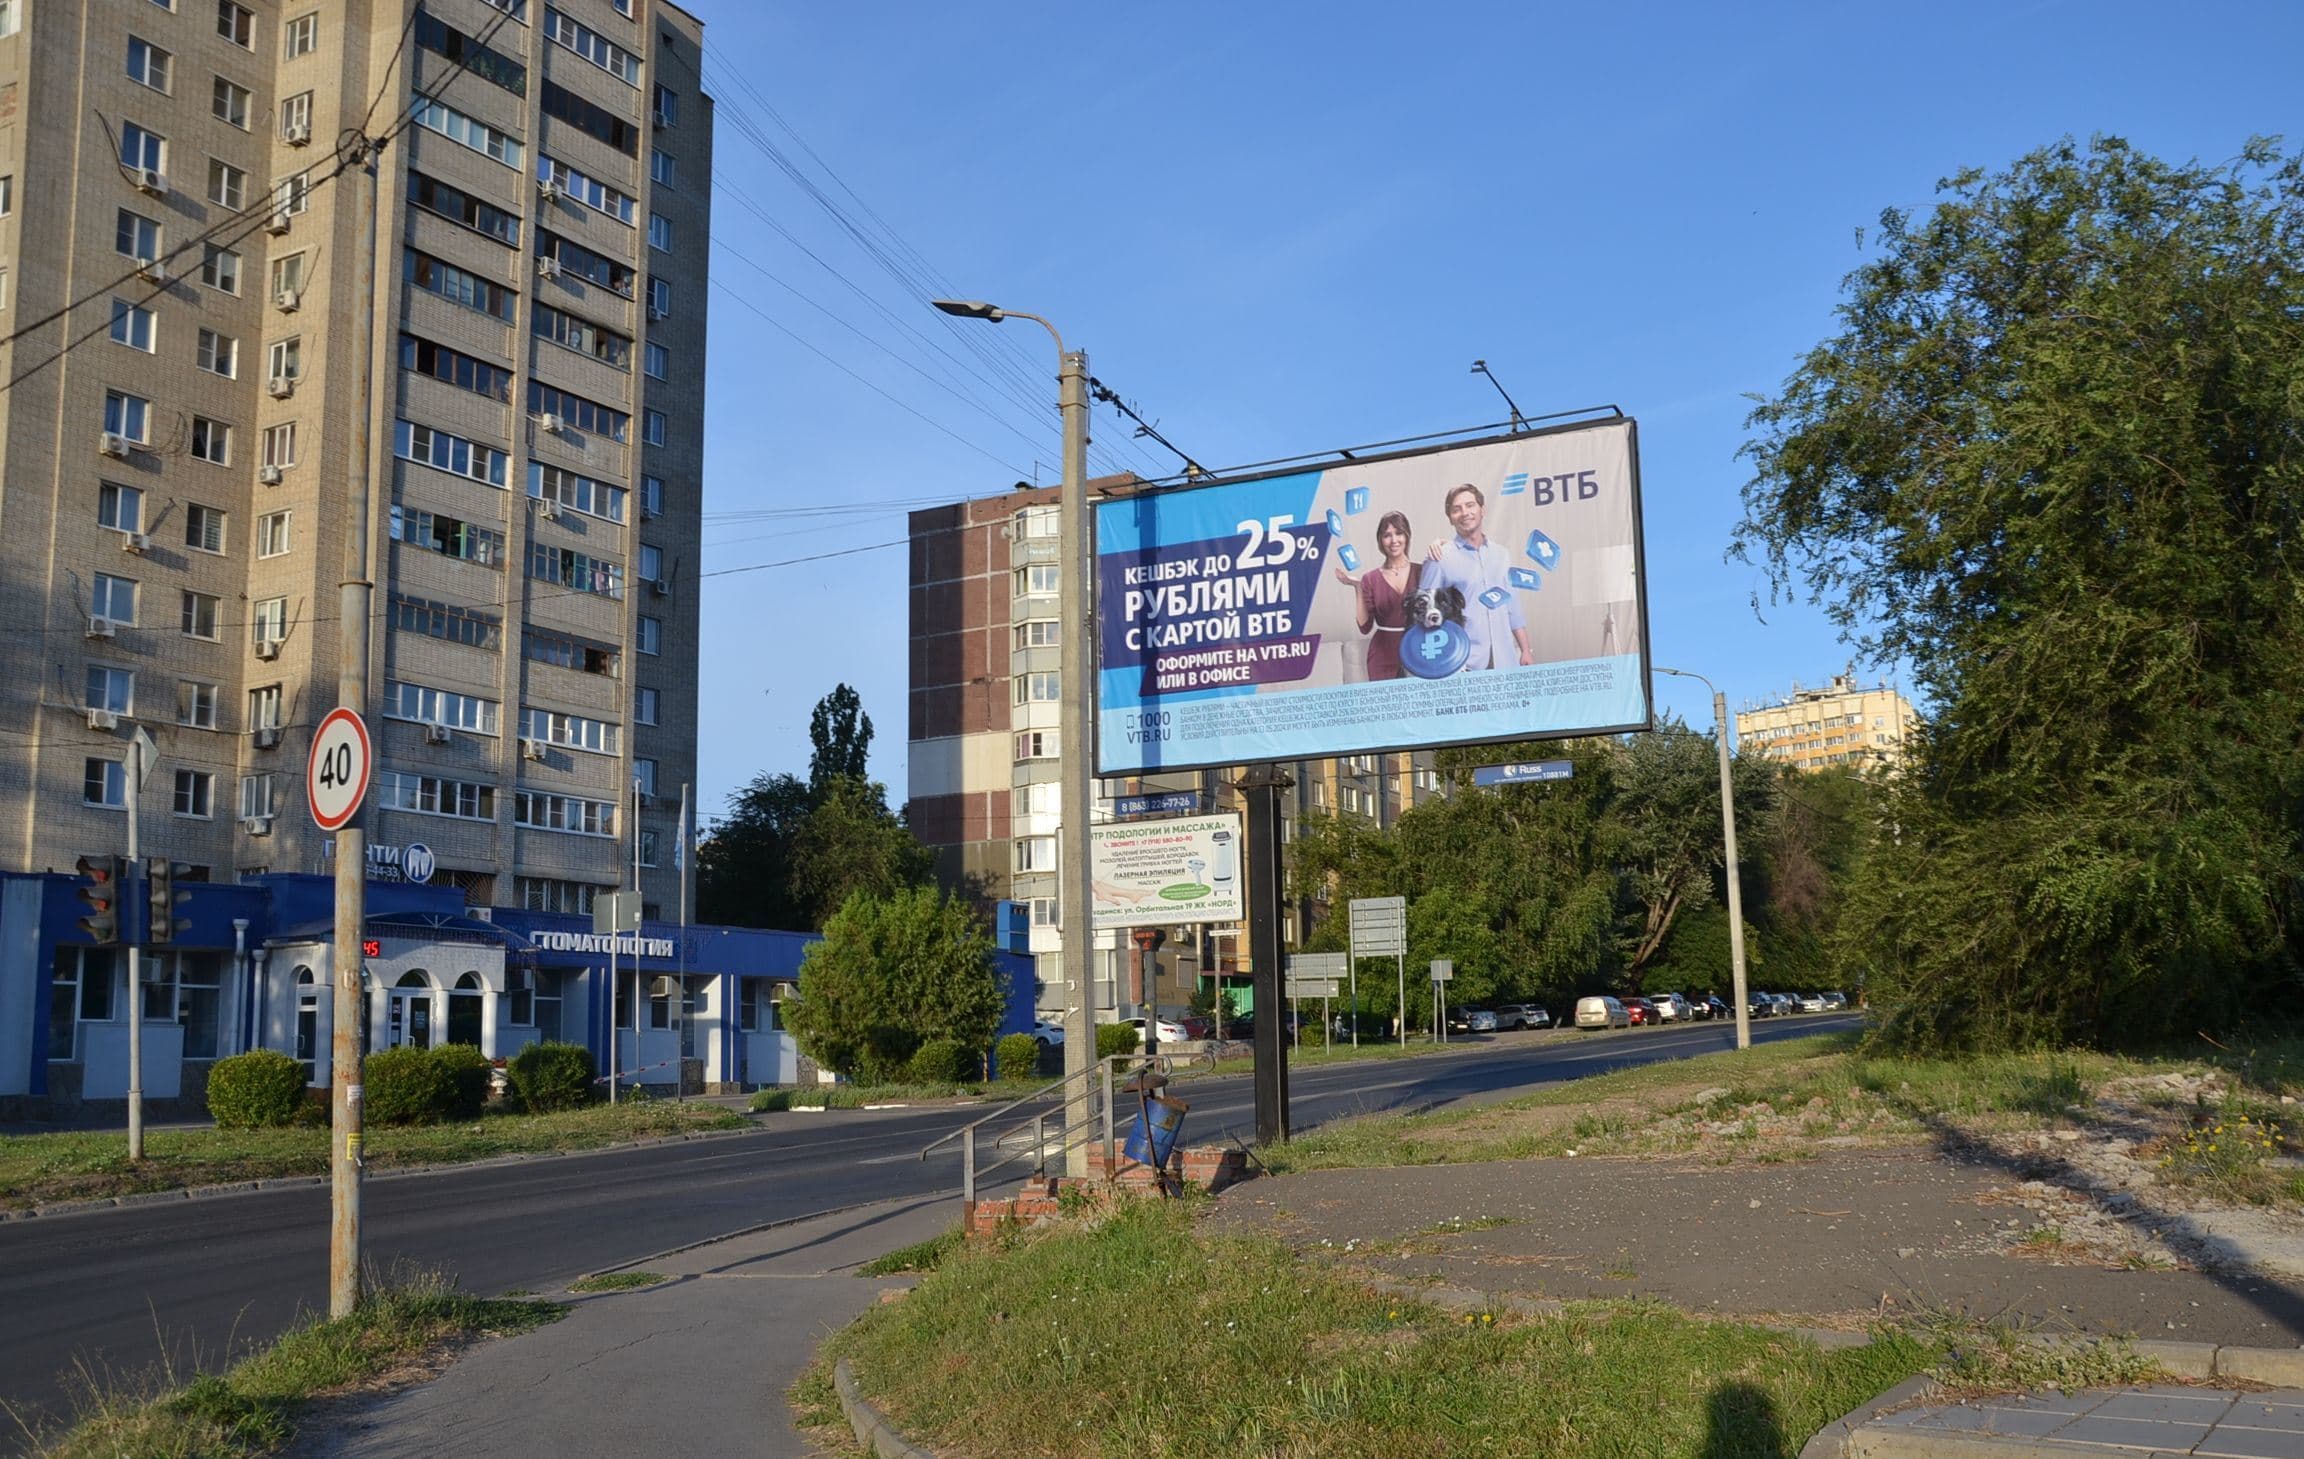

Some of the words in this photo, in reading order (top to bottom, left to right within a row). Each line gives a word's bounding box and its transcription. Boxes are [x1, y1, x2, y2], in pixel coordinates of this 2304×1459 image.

[1534, 470, 1598, 506] ВТБ
[1125, 558, 1198, 585] КЕШБЭК
[1203, 554, 1231, 577] ДО
[1235, 514, 1319, 570] 25%
[1125, 570, 1290, 622] РУБЛЯМИ
[1126, 628, 1141, 650] С
[1146, 611, 1240, 648] КАРТОЙ
[1248, 610, 1292, 637] ВТБ
[1156, 650, 1233, 672] ОФОРМИТЕ
[1236, 648, 1258, 663] НА
[1260, 641, 1311, 660] VTB.RU
[1156, 673, 1186, 689] ИЛИ
[1188, 671, 1198, 685] В
[1200, 665, 1250, 684] ОФИСЕ
[1137, 711, 1171, 728] 1000
[1127, 728, 1171, 744] VTB.RU
[320, 742, 351, 790] 40
[1519, 765, 1542, 774] Russ
[1121, 803, 1128, 812] 8
[1106, 828, 1162, 840] ПОДОЛОГИИ
[1172, 821, 1226, 834] МАССАЖА»
[1136, 903, 1184, 913] Орбитальная
[529, 930, 674, 957] СТОМАТОЛОГИЯ
